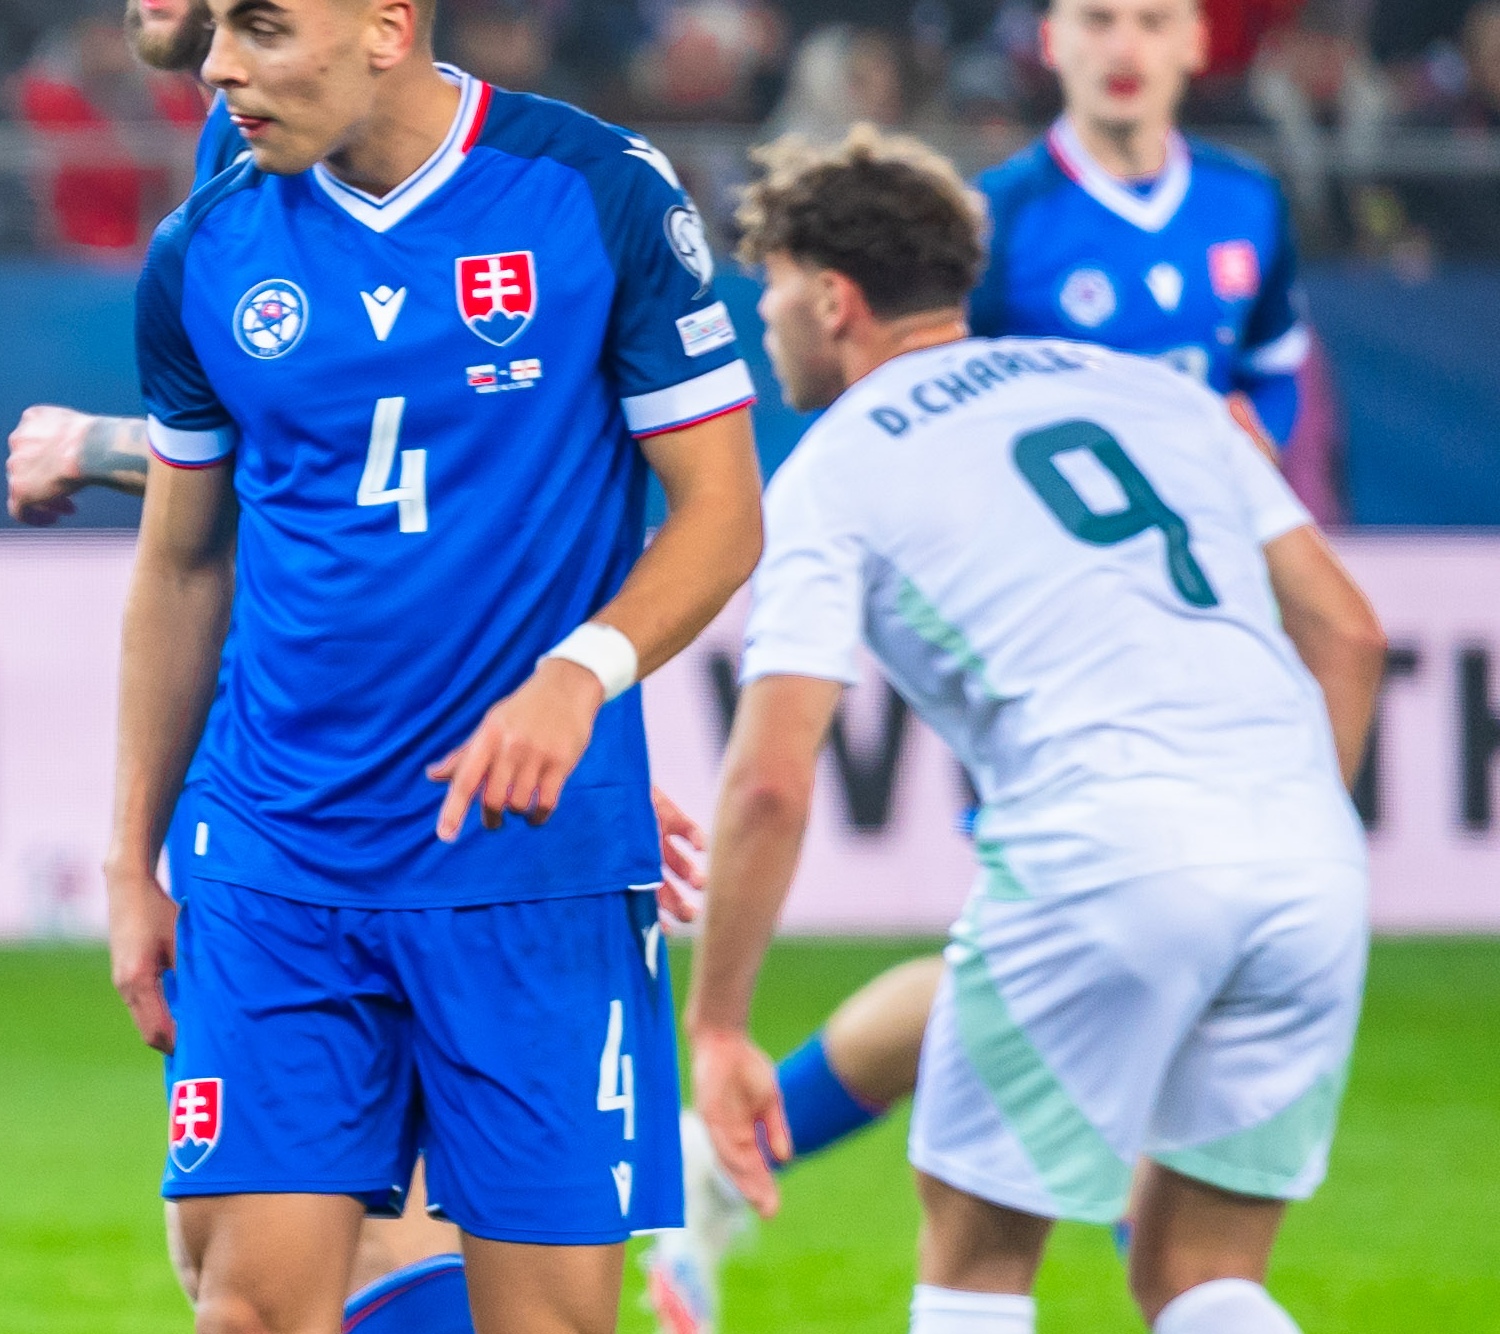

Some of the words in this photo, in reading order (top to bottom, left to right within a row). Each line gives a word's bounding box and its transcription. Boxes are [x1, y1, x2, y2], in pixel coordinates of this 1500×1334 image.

[356, 396, 429, 534] 4
[1010, 419, 1220, 609] 9
[596, 998, 636, 1141] 4
